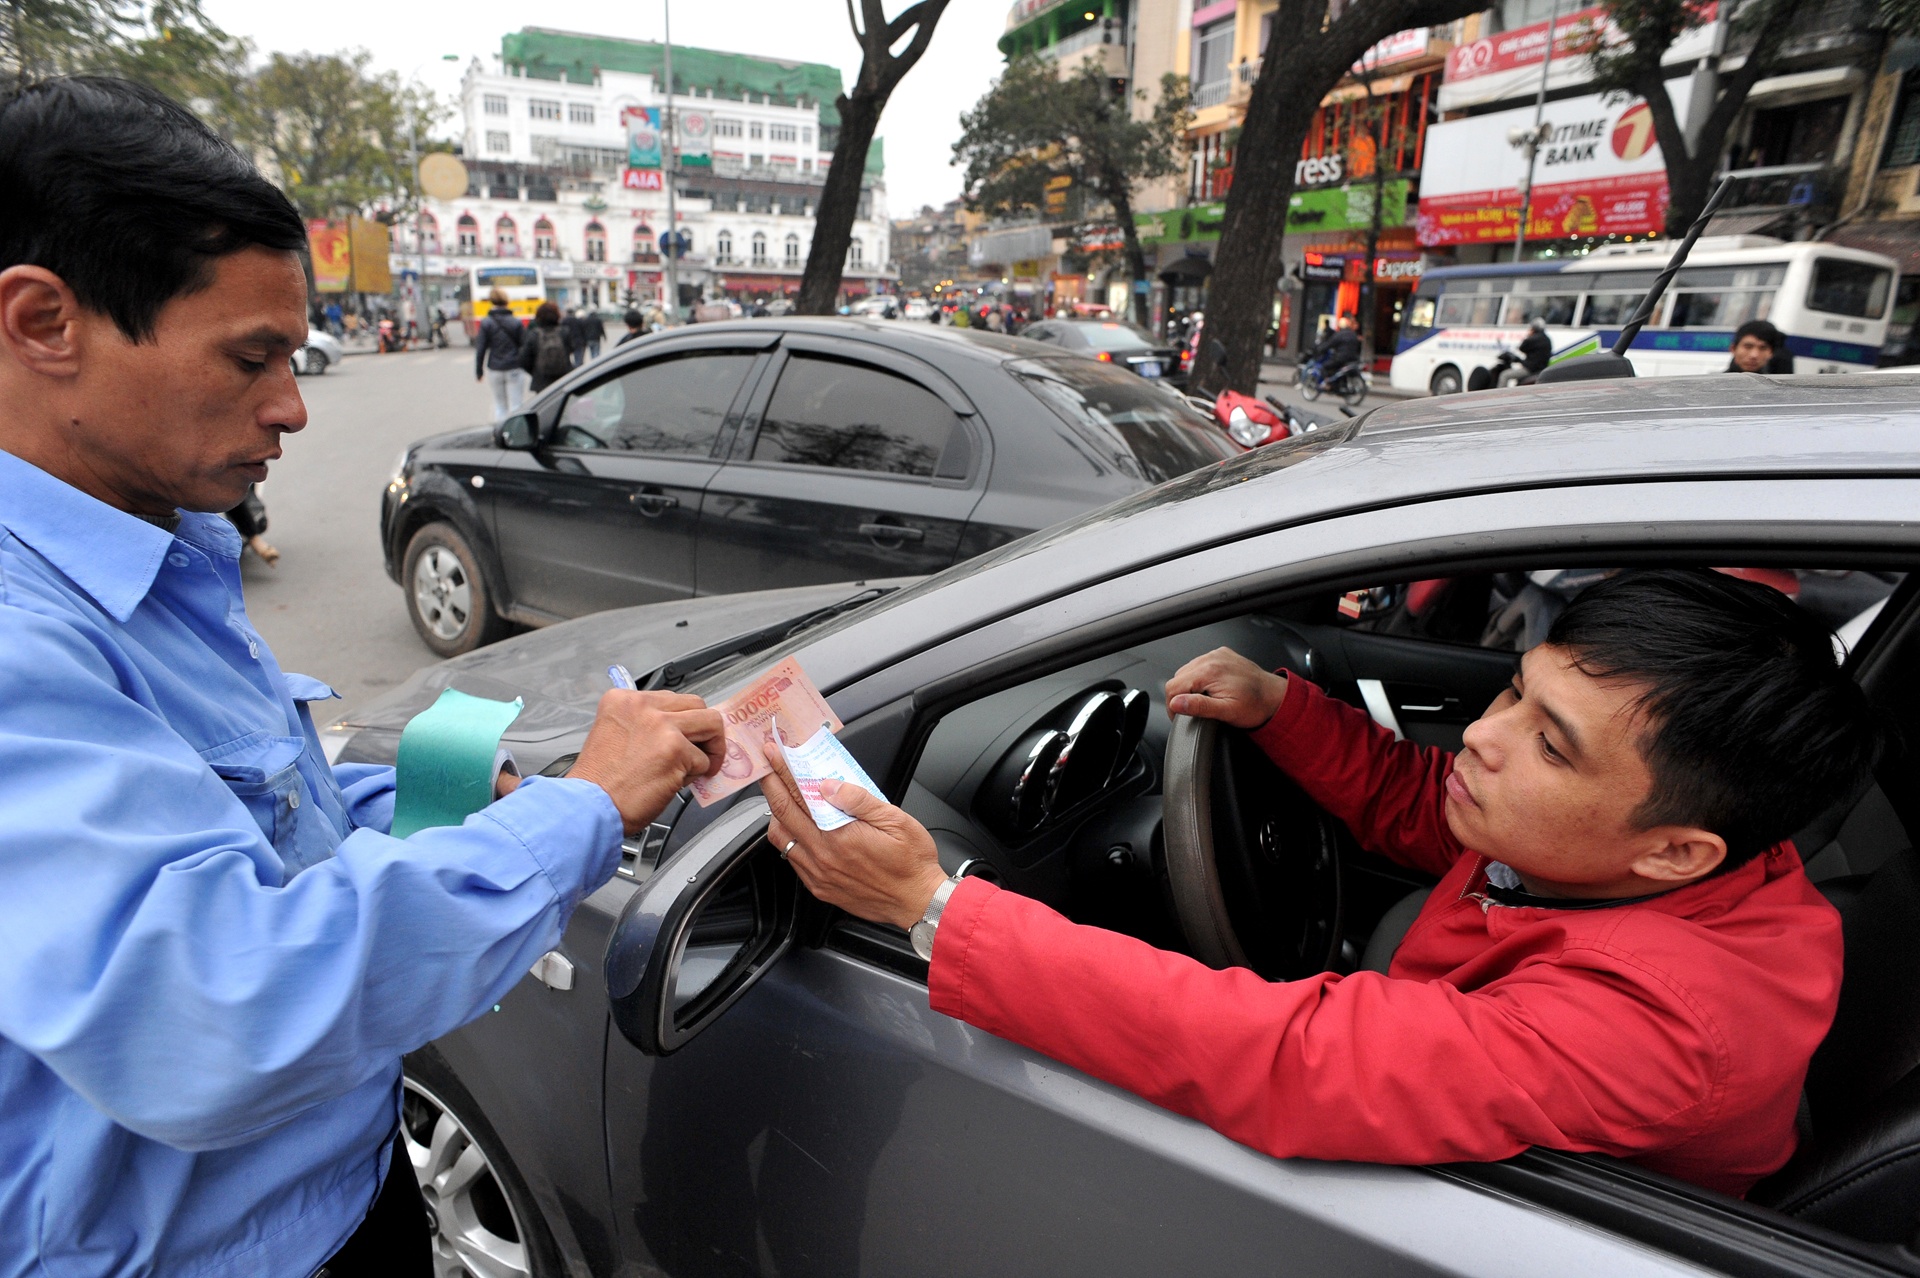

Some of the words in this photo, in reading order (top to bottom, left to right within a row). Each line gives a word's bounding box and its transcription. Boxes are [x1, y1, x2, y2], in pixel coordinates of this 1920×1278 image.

[1545, 141, 1599, 166] BANK
[626, 171, 660, 189] AIA
[1295, 154, 1342, 185] ress
[1377, 258, 1423, 281] Expres
